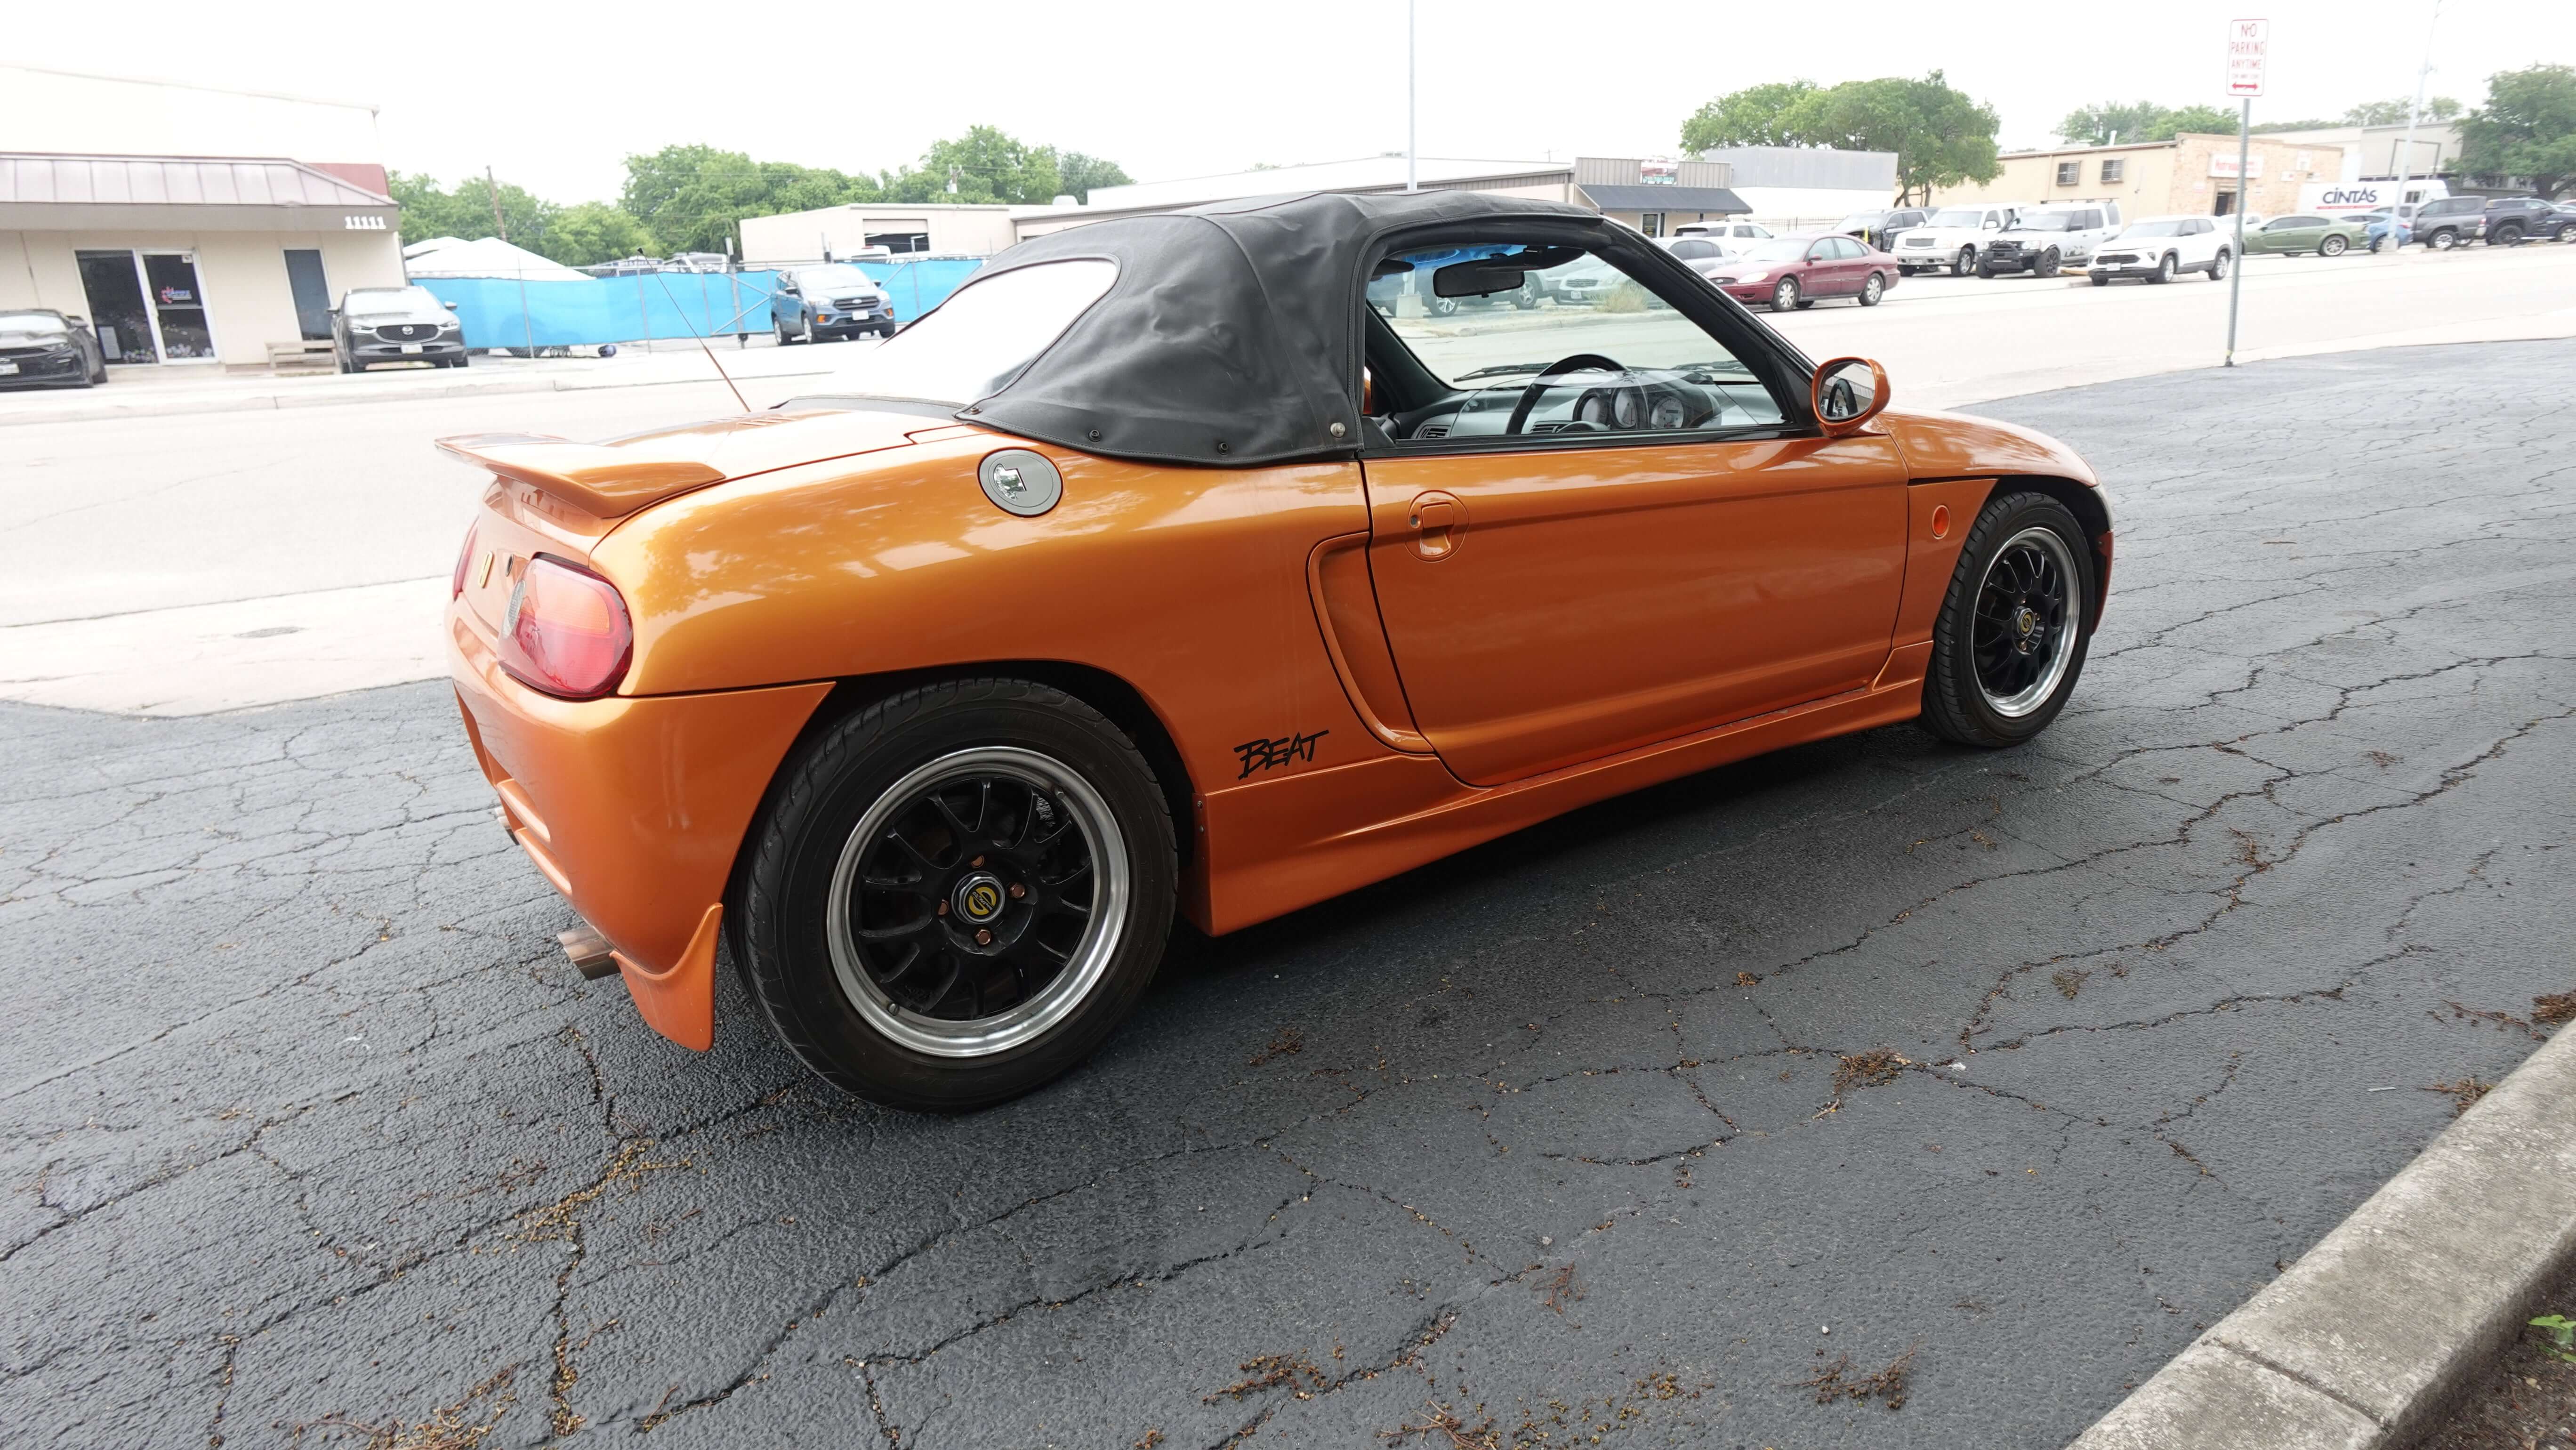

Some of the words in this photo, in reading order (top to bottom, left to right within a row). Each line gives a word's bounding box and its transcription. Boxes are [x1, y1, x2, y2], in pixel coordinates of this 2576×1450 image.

[2241, 24, 2257, 37] NO
[2231, 41, 2264, 55] PARKING
[2231, 59, 2262, 69] ANYTIME
[345, 216, 386, 229] 11111
[1233, 730, 1329, 780] BEAT
